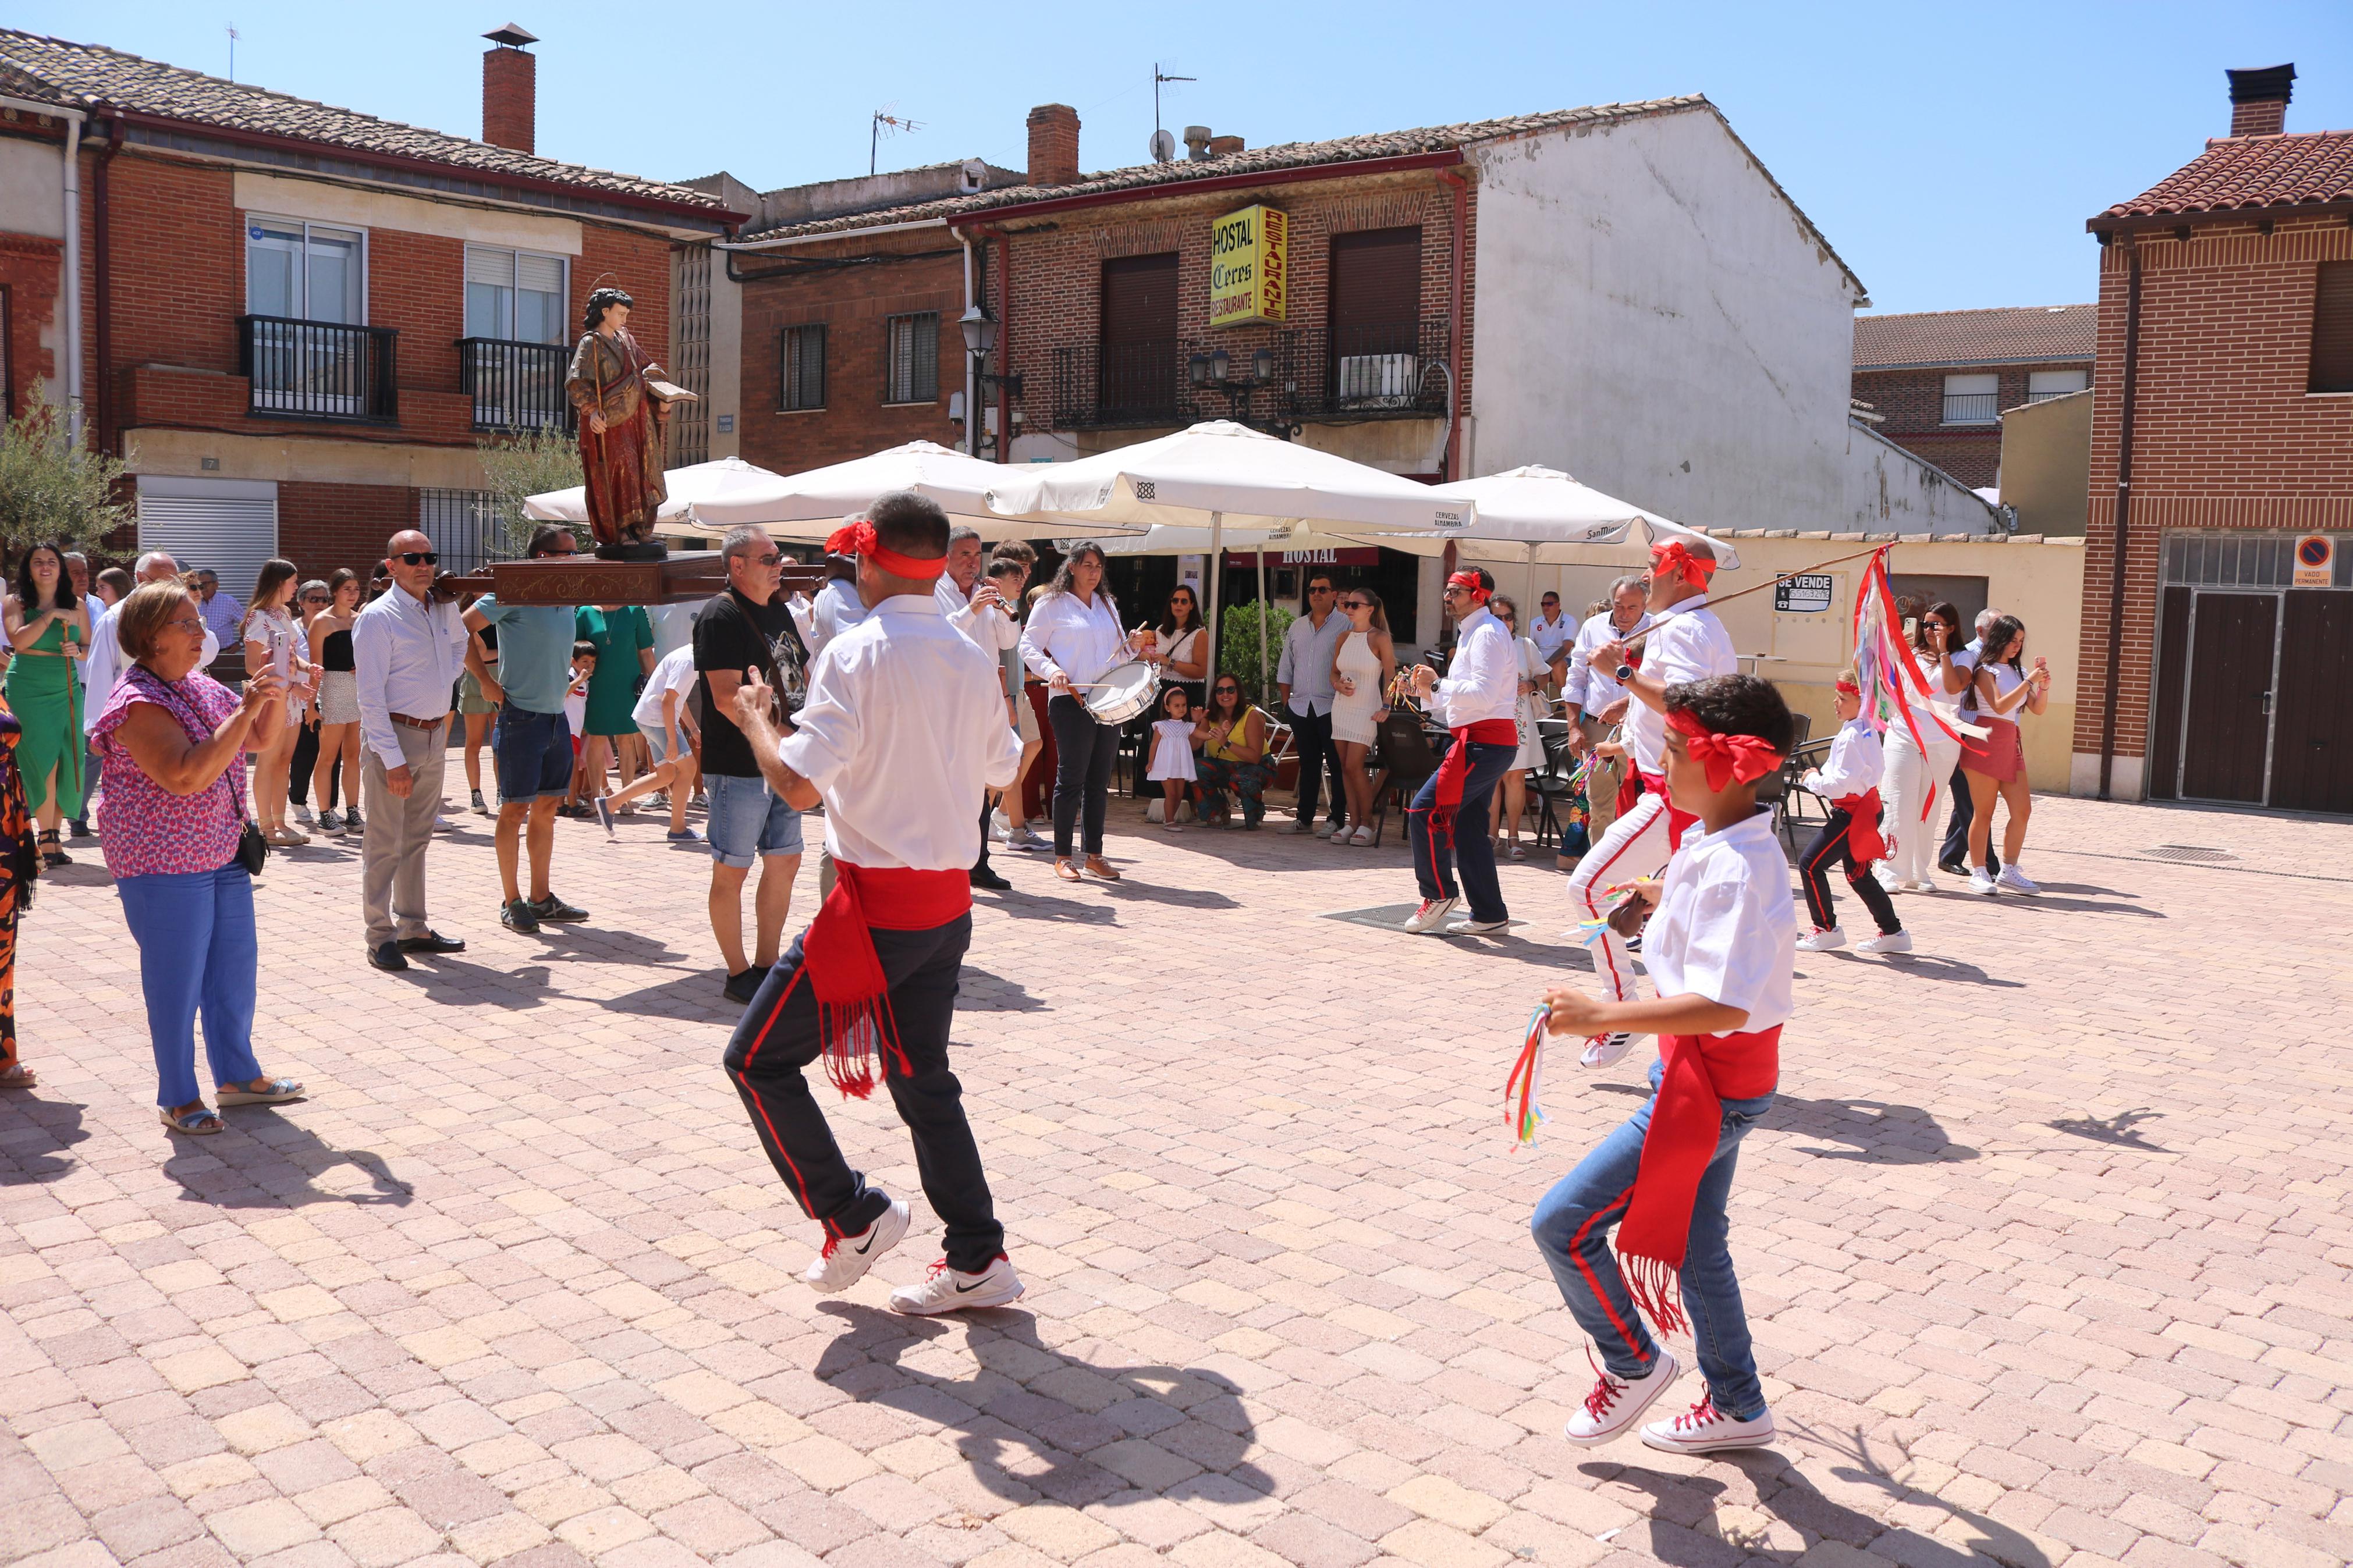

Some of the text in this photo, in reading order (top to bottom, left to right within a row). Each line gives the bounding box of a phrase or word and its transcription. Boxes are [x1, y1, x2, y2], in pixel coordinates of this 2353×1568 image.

[1213, 218, 1252, 256] HOSTAL
[1264, 210, 1283, 319] RESTAURANTE
[1213, 262, 1252, 289] Ceres
[1211, 291, 1252, 318] RESTAURANTE
[208, 460, 214, 468] 7
[1435, 511, 1459, 520] CERVEZAS
[1283, 549, 1337, 563] HOSTAL
[1795, 576, 1830, 589] VENDE
